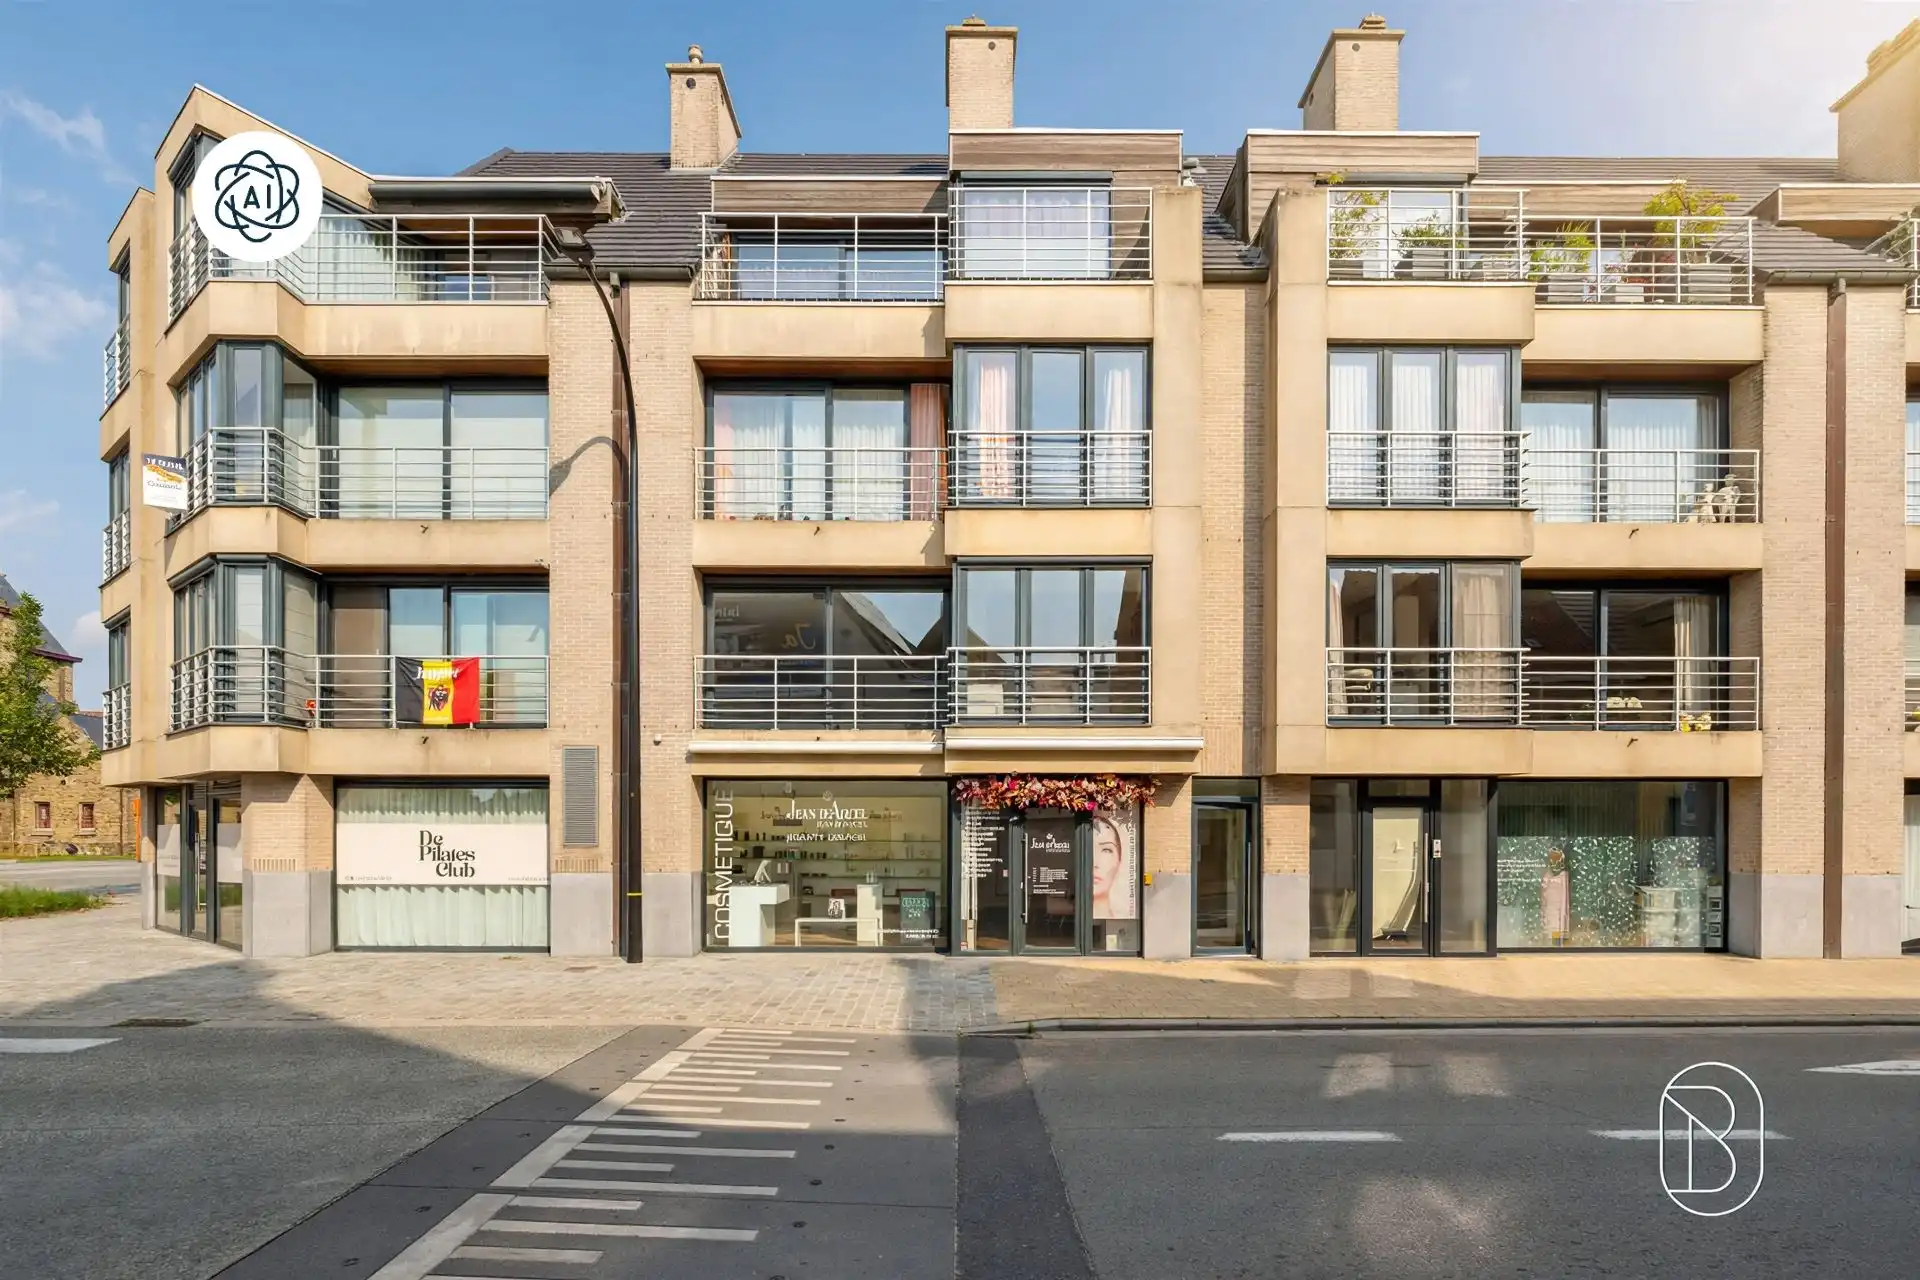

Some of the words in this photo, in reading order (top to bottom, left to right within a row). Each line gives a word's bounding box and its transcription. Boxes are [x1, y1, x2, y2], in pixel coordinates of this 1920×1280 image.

[419, 830, 444, 846] De
[419, 845, 476, 862] Pilates
[436, 862, 476, 878] Club
[715, 789, 734, 939] COSMETIQUE
